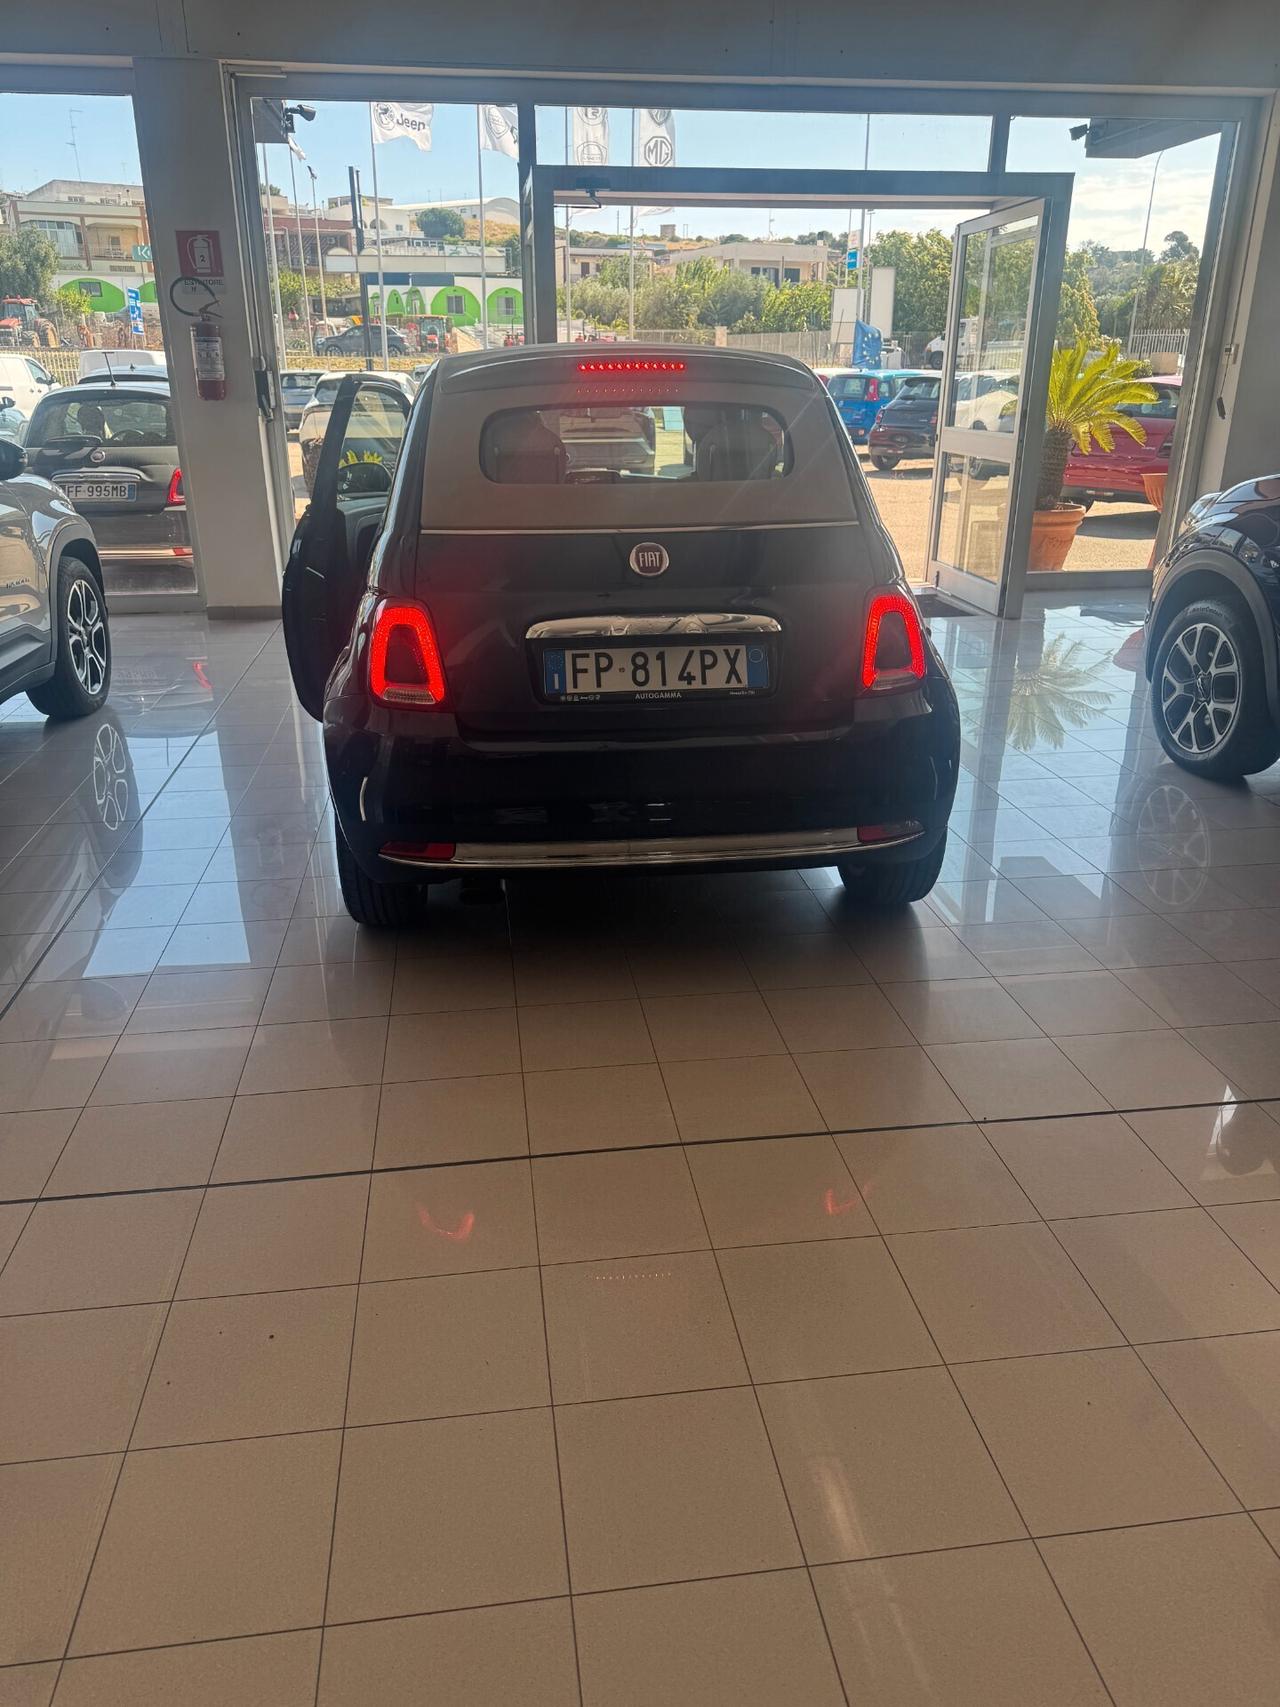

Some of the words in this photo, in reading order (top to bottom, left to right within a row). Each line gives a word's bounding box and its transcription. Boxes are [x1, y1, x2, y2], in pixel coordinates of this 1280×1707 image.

[647, 139, 670, 165] MG
[638, 551, 661, 568] FIAT
[635, 691, 682, 700] AUTOGAMMA
